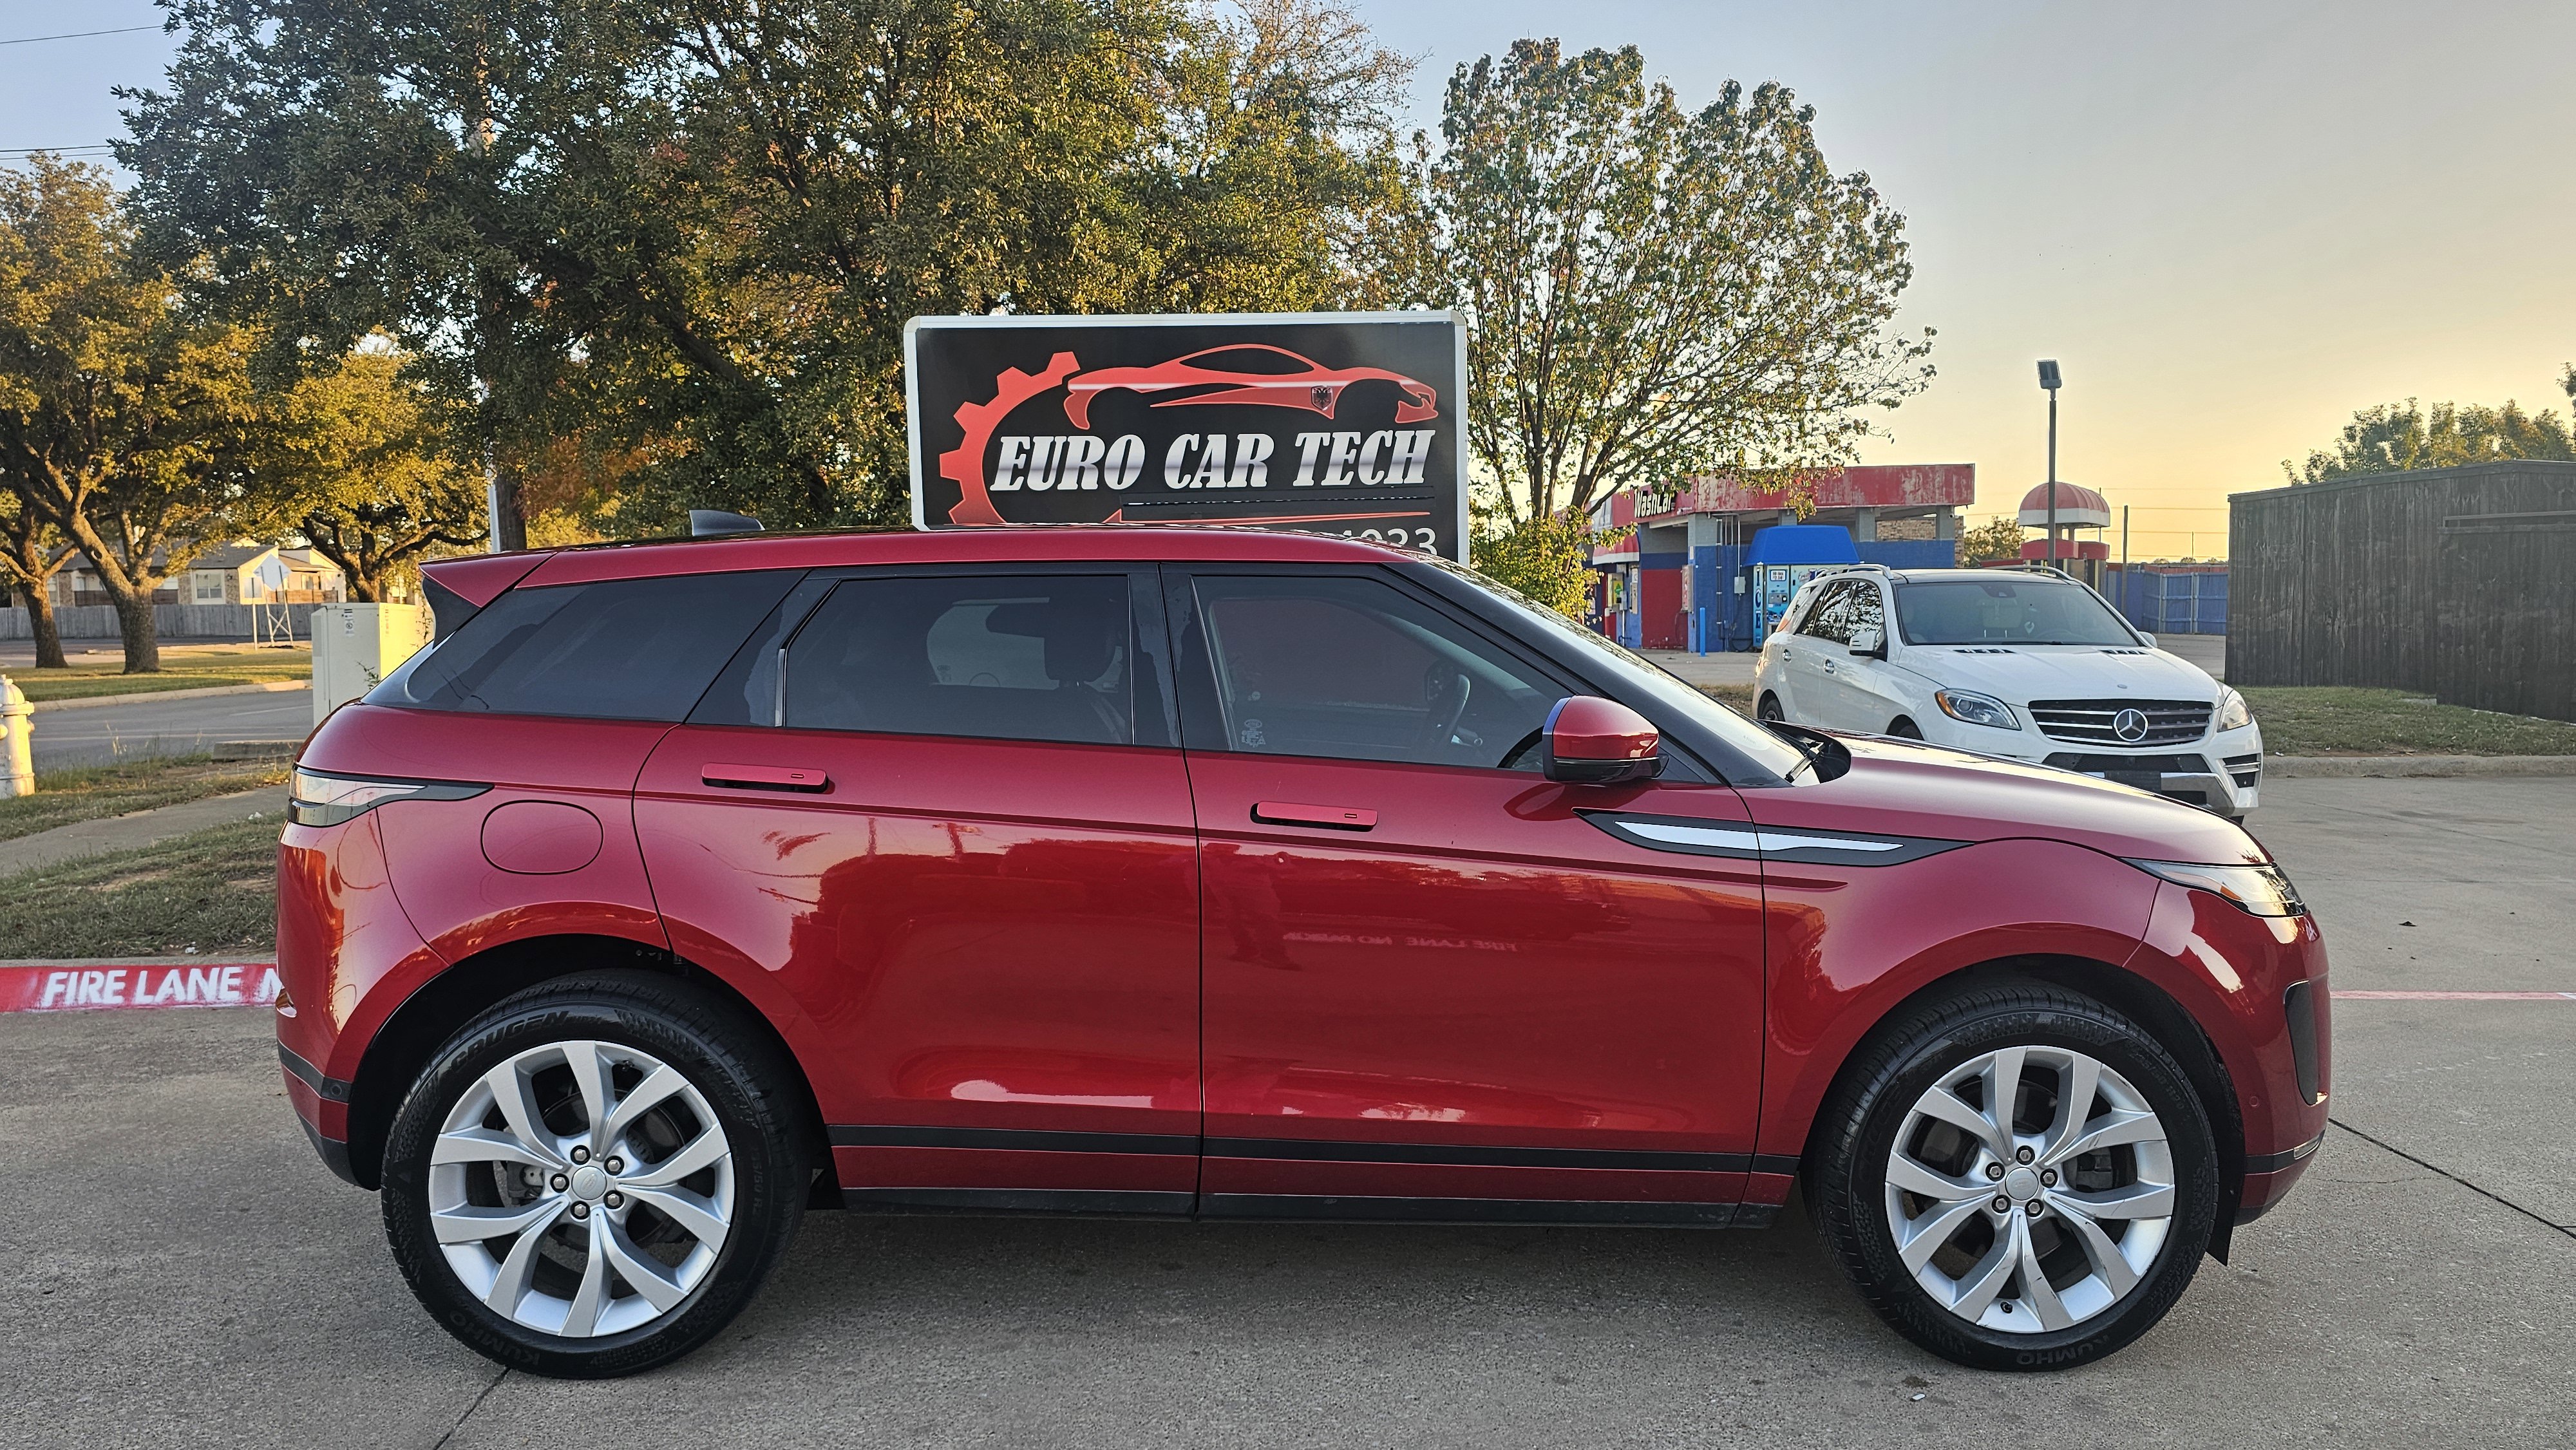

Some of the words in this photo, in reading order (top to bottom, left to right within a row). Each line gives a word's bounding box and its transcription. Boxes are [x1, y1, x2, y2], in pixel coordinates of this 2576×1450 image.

[990, 433, 1146, 491] EURO
[1163, 431, 1274, 489] CAR
[1293, 428, 1436, 487] TECH
[41, 969, 127, 1008] FIRE
[133, 966, 243, 1005] LANE
[2016, 1334, 2110, 1365] KUMHO
